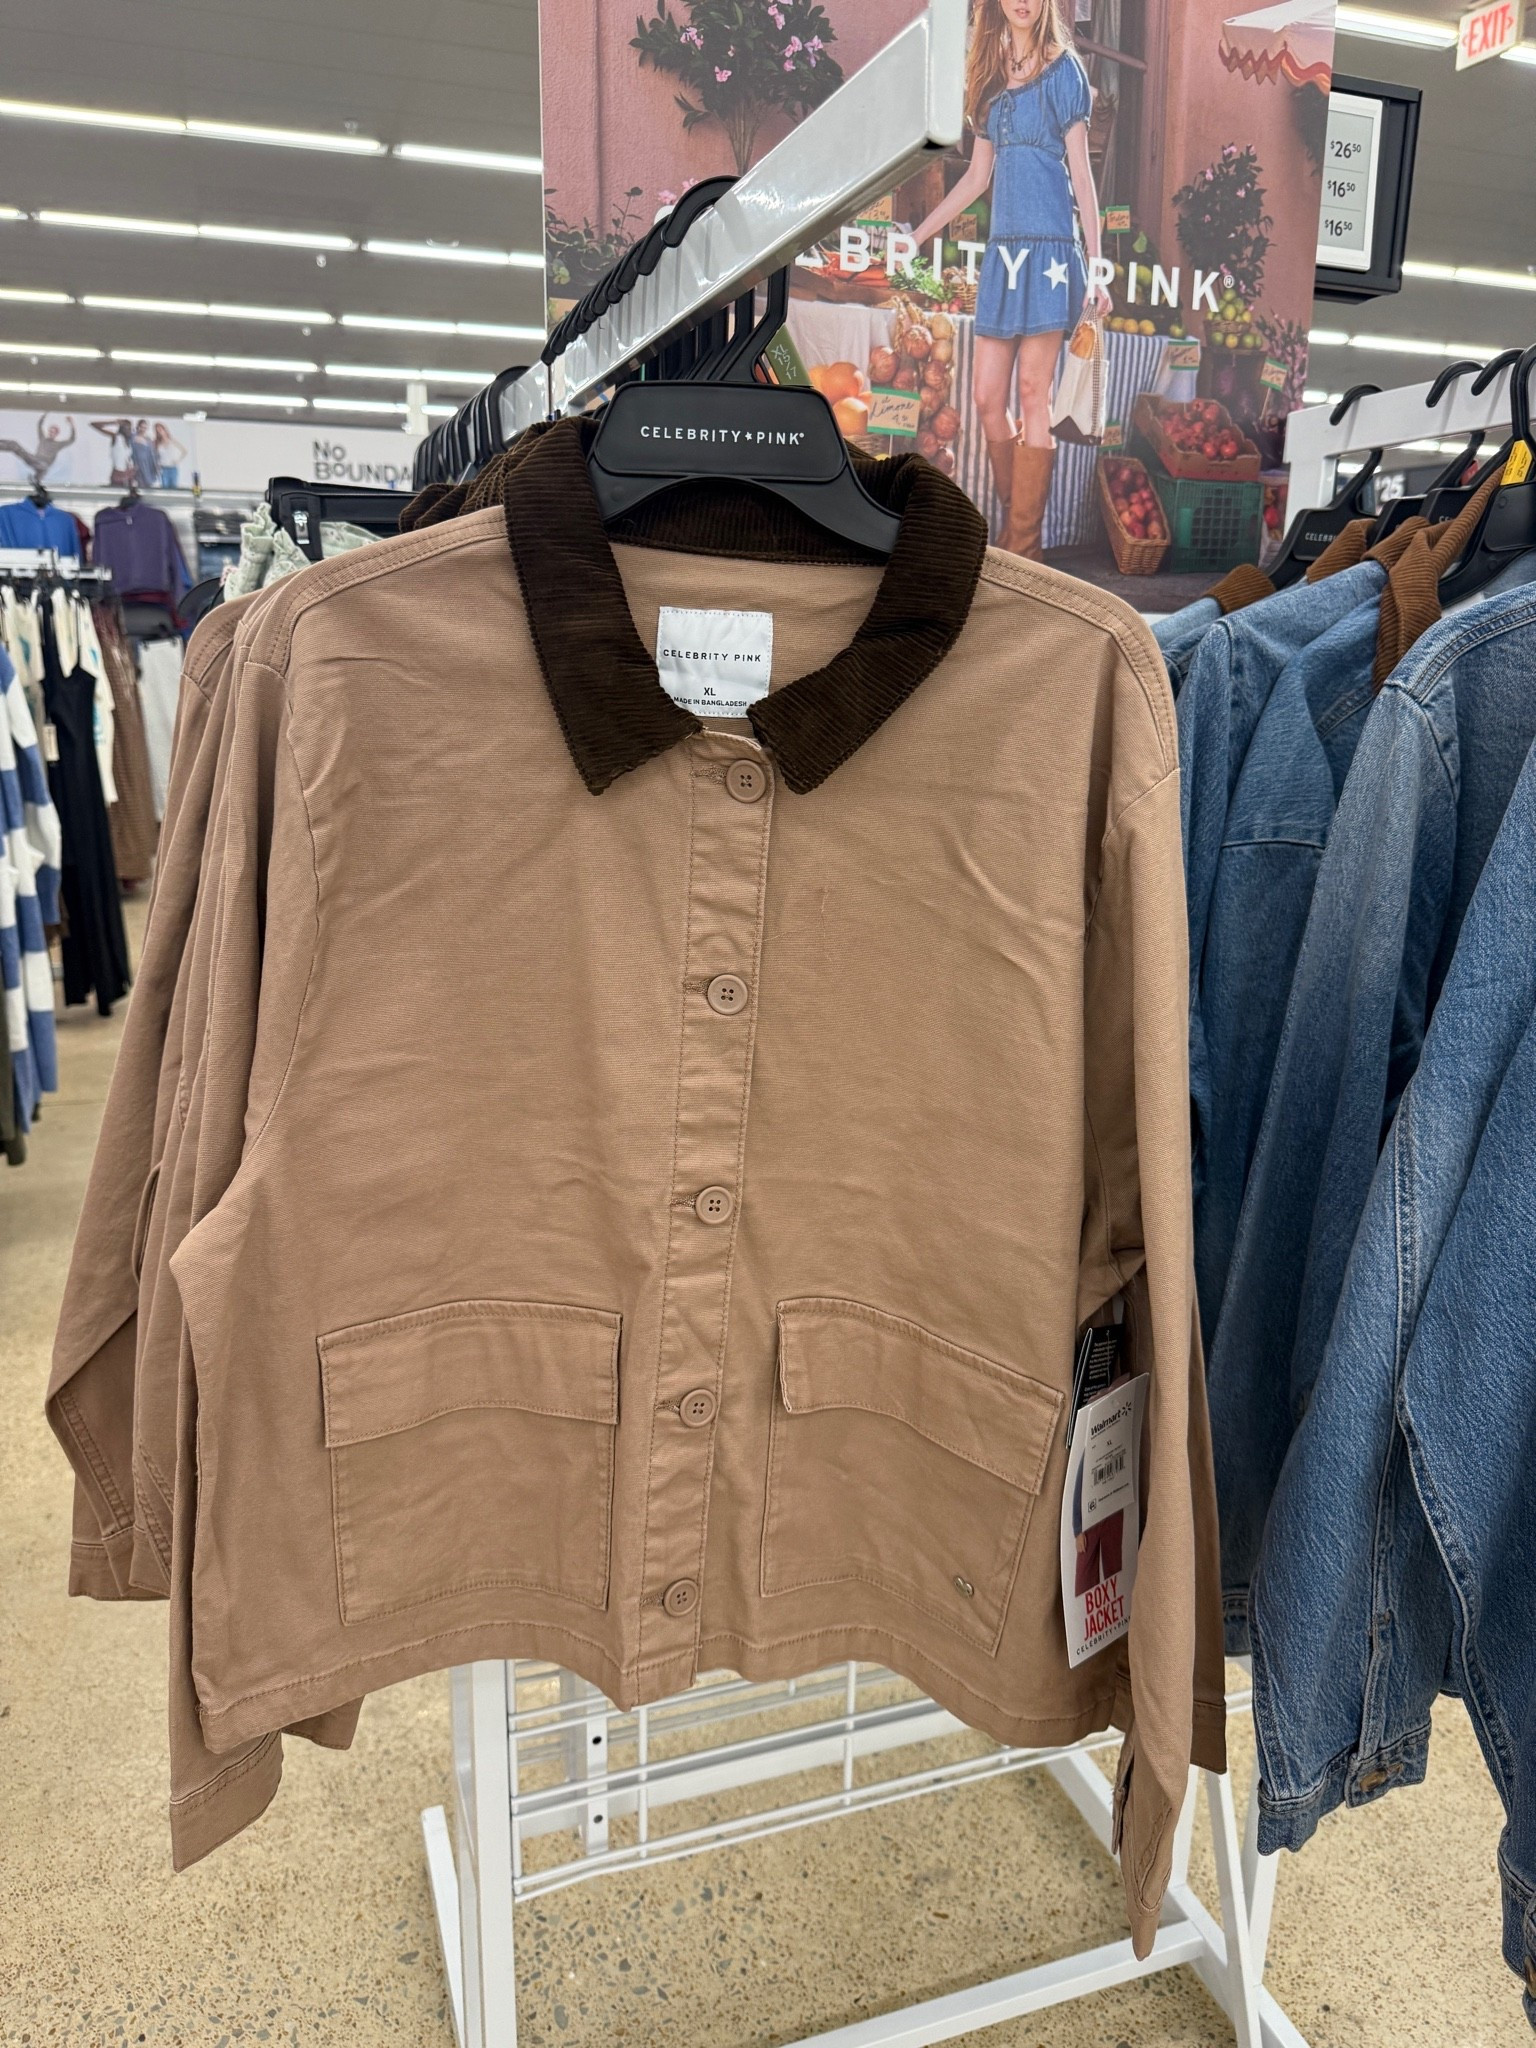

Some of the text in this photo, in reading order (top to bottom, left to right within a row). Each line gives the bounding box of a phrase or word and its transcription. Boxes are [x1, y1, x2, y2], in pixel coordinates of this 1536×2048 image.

[1468, 3, 1510, 58] EXIT
[640, 425, 742, 444] CELEBRITY
[663, 649, 761, 662] CELEBRITY PINK
[673, 696, 692, 705] MADE
[701, 699, 747, 707] BANGLADESH
[703, 687, 717, 697] XL
[1091, 1410, 1121, 1435] Walmart
[1085, 1576, 1117, 1614] BOXY
[1084, 1596, 1124, 1641] JACKET
[1076, 1629, 1113, 1655] CELEBRITY
